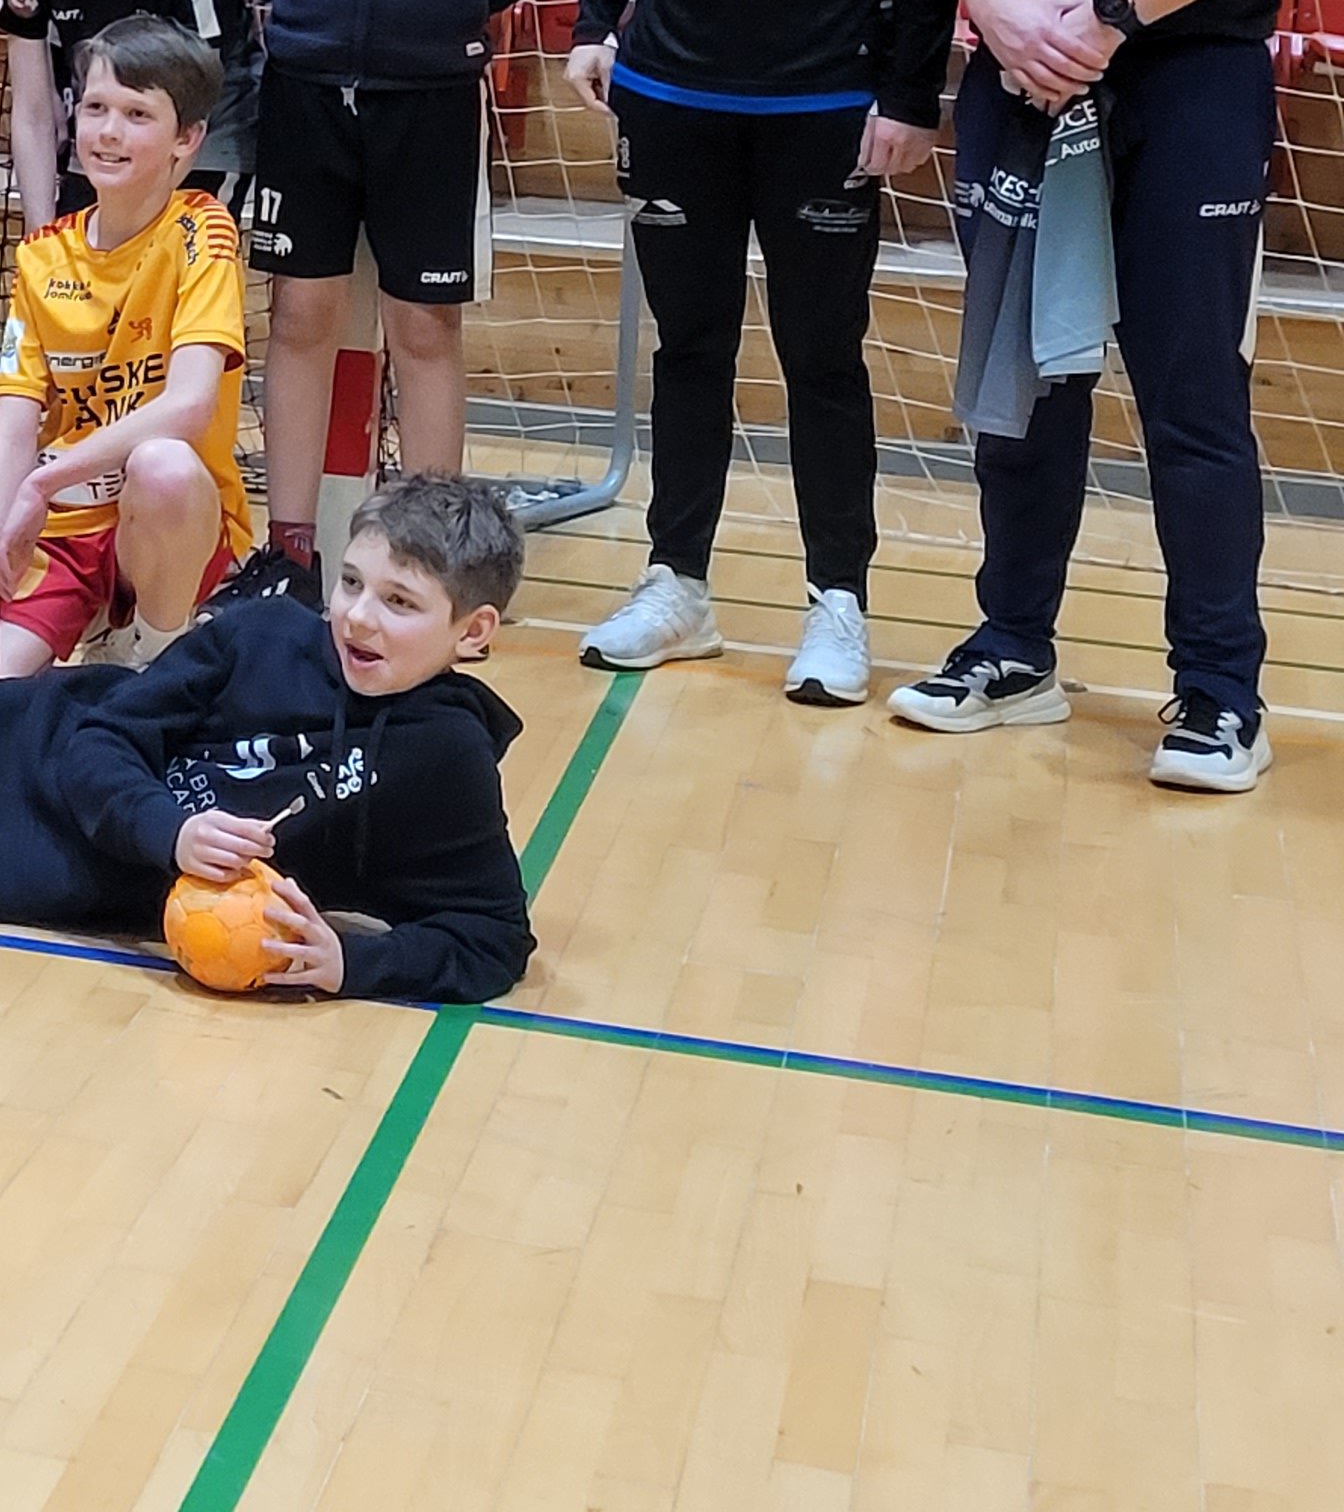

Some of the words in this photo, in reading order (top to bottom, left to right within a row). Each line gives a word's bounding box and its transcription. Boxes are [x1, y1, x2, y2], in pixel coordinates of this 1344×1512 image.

[260, 186, 283, 225] 17
[1199, 201, 1250, 217] CRAFT
[420, 271, 462, 284] CRAFT
[75, 391, 145, 431] ANK
